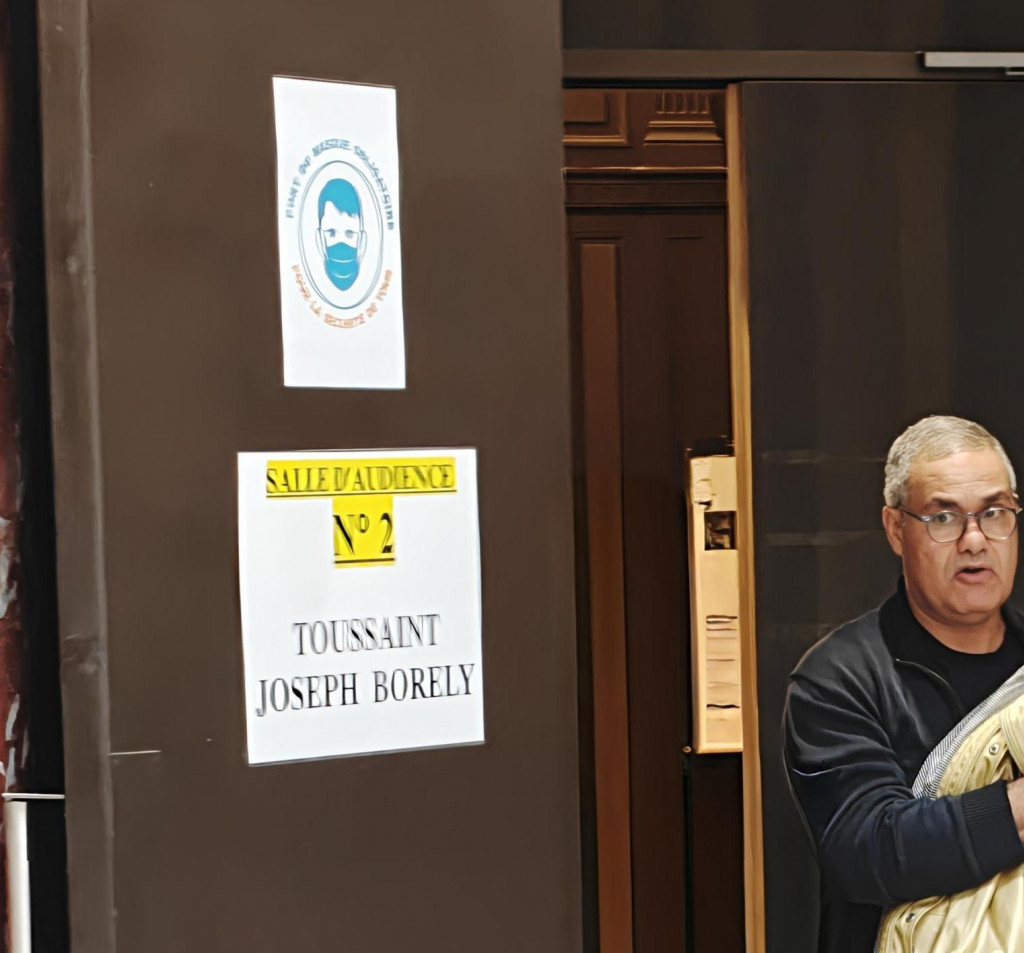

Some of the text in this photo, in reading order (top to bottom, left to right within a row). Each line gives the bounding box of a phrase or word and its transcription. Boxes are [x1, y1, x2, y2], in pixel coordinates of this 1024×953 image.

[266, 464, 456, 493] SALLE D'AUDIENCE
[380, 512, 394, 555] 2
[292, 613, 441, 656] TOUSSAINT
[255, 662, 476, 717] JOSEPH BORELY
